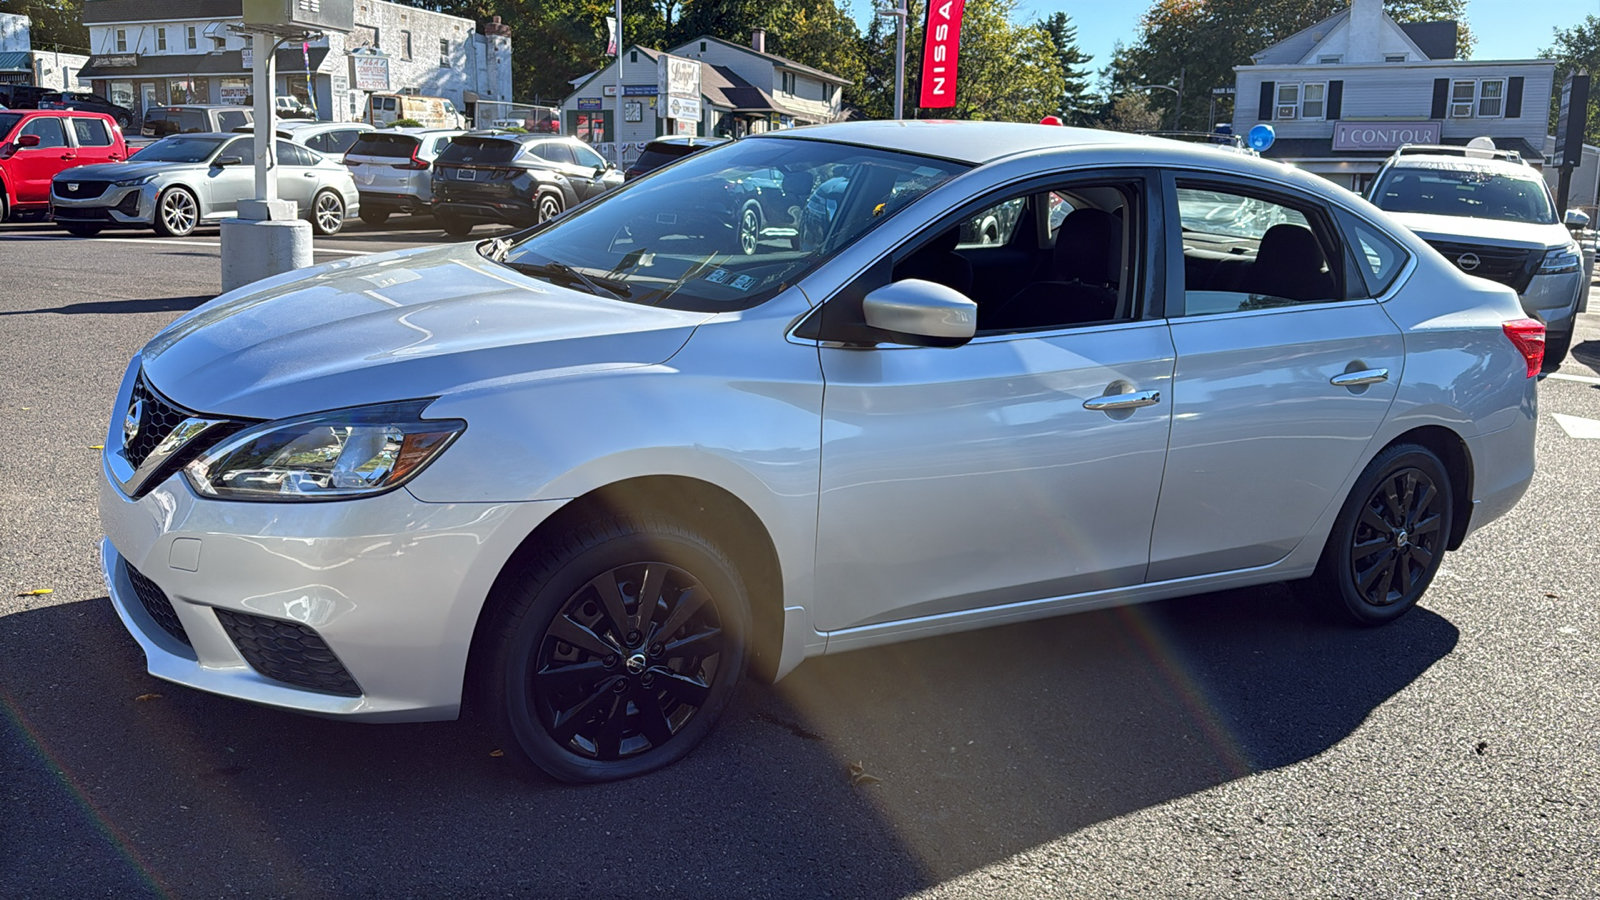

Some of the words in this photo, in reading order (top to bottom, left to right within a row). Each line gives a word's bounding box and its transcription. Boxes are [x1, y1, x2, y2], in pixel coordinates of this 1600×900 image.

[357, 66, 387, 74] COMPUTERS
[221, 88, 249, 97] COMPUTERS
[1350, 128, 1432, 144] CONTOUR
